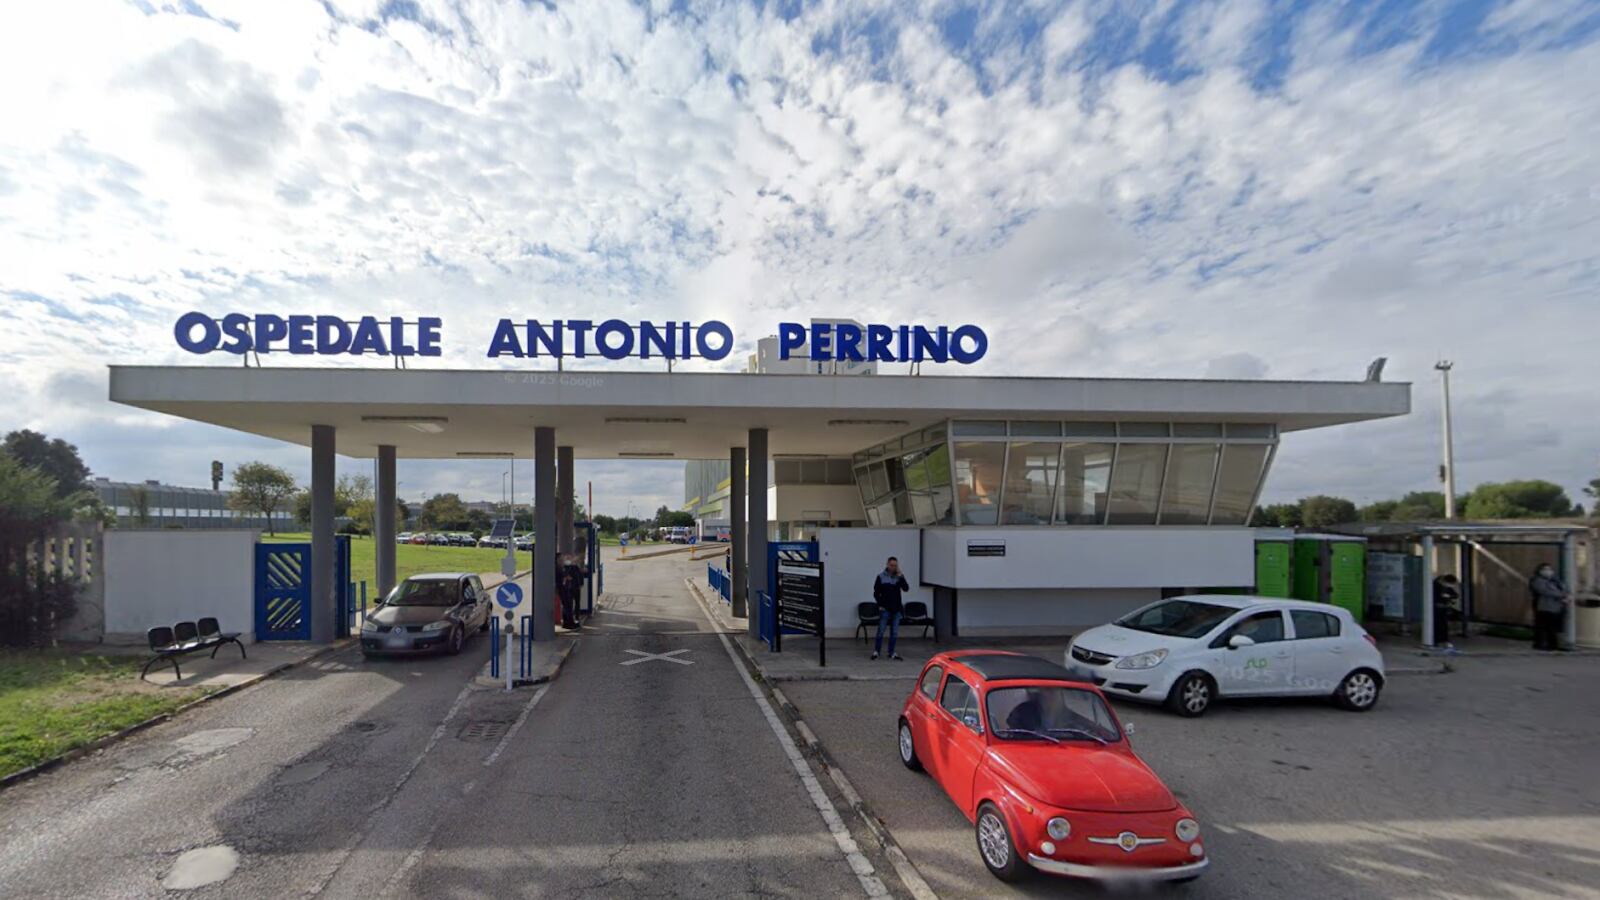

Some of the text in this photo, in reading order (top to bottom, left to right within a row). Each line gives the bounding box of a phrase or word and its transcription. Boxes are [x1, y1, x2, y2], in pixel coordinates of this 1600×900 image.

[174, 311, 988, 364] OSPEDALE ANTONIO PERRINO
